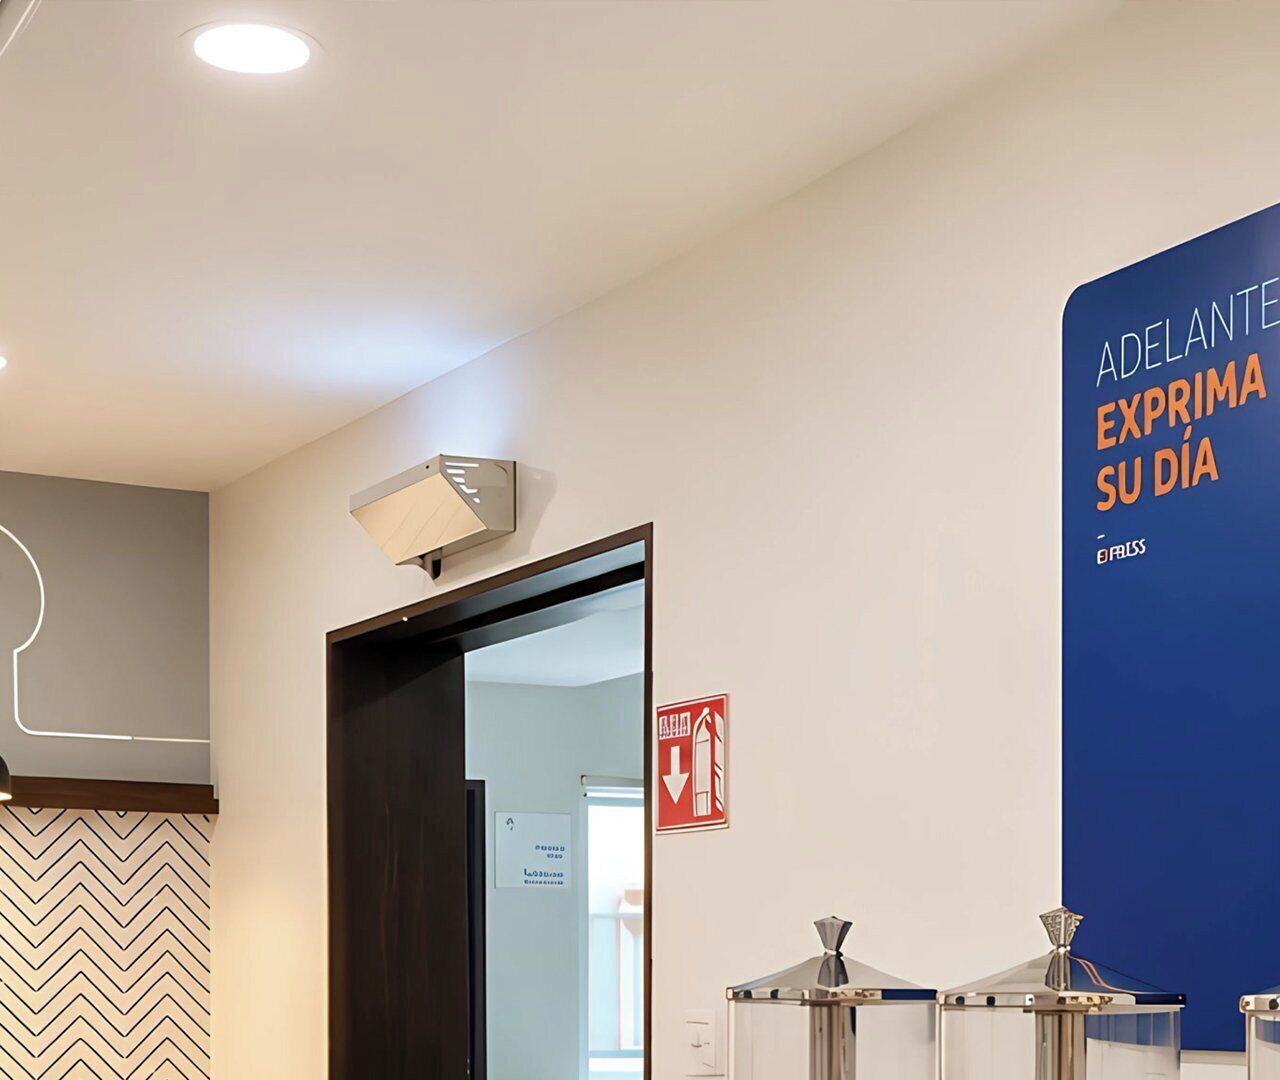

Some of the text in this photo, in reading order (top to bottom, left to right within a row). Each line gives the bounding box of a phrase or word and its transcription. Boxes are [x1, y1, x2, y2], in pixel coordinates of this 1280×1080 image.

[1096, 353, 1268, 451] EXPRIMA
[1096, 425, 1220, 512] SU DÍA
